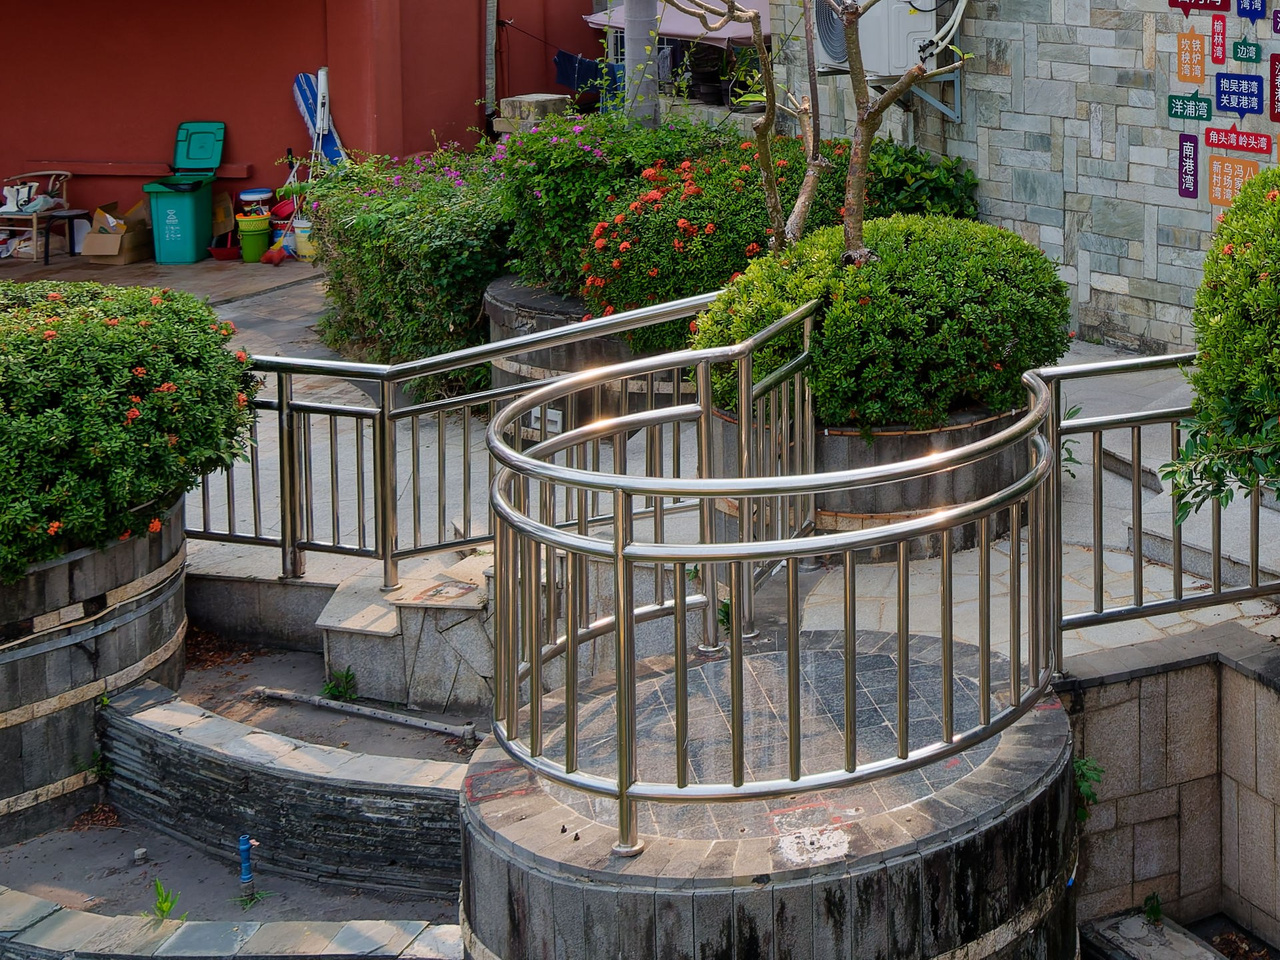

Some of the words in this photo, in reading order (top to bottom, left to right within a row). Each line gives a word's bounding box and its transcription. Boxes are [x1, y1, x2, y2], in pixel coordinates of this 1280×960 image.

[1191, 39, 1201, 78] 铁炉湾
[1213, 20, 1223, 59] 榆林湾
[1237, 45, 1256, 59] 边湾
[1220, 78, 1258, 94] 抱吴港湾
[1171, 99, 1207, 118] 洋浦湾
[1209, 130, 1237, 147] 角头湾
[1238, 134, 1267, 150] 岭头湾
[1182, 141, 1194, 192] 南港湾
[1212, 160, 1222, 200] 新村湾
[1223, 162, 1232, 202] 乌场湾
